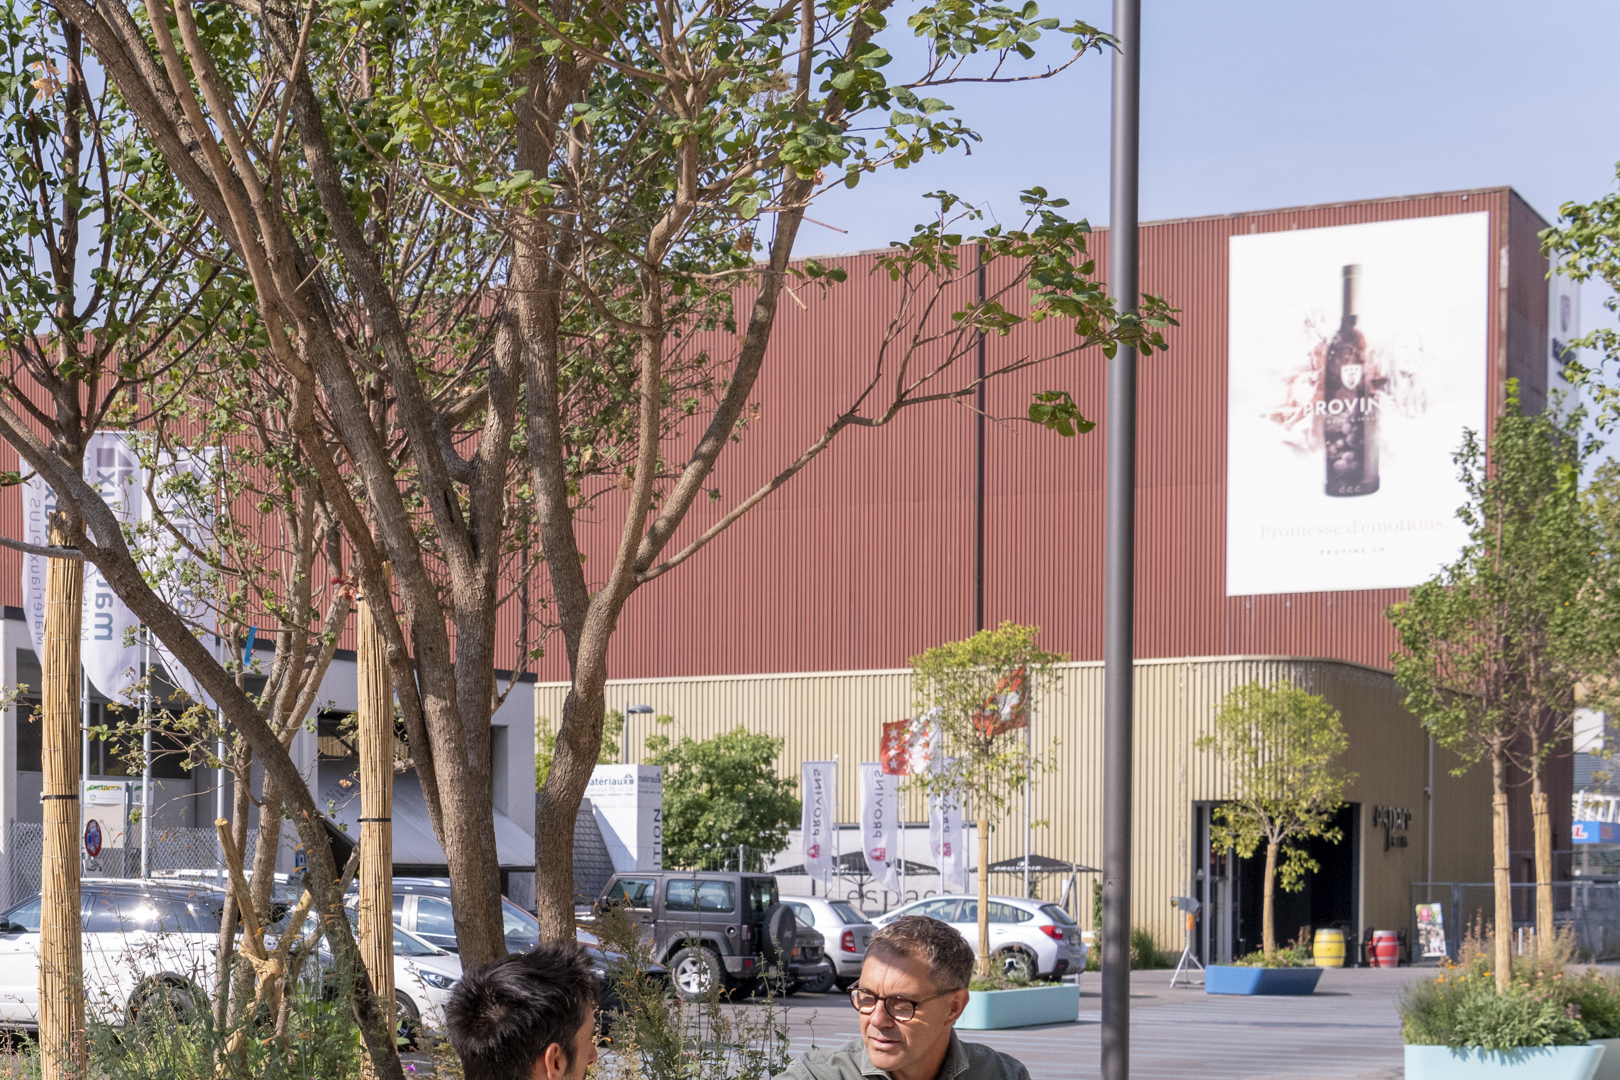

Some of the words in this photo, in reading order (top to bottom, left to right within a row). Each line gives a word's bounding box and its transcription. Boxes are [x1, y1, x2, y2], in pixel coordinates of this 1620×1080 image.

[1303, 397, 1383, 416] PROVIN
[1260, 524, 1343, 540] Promesse
[589, 776, 628, 786] atériaux
